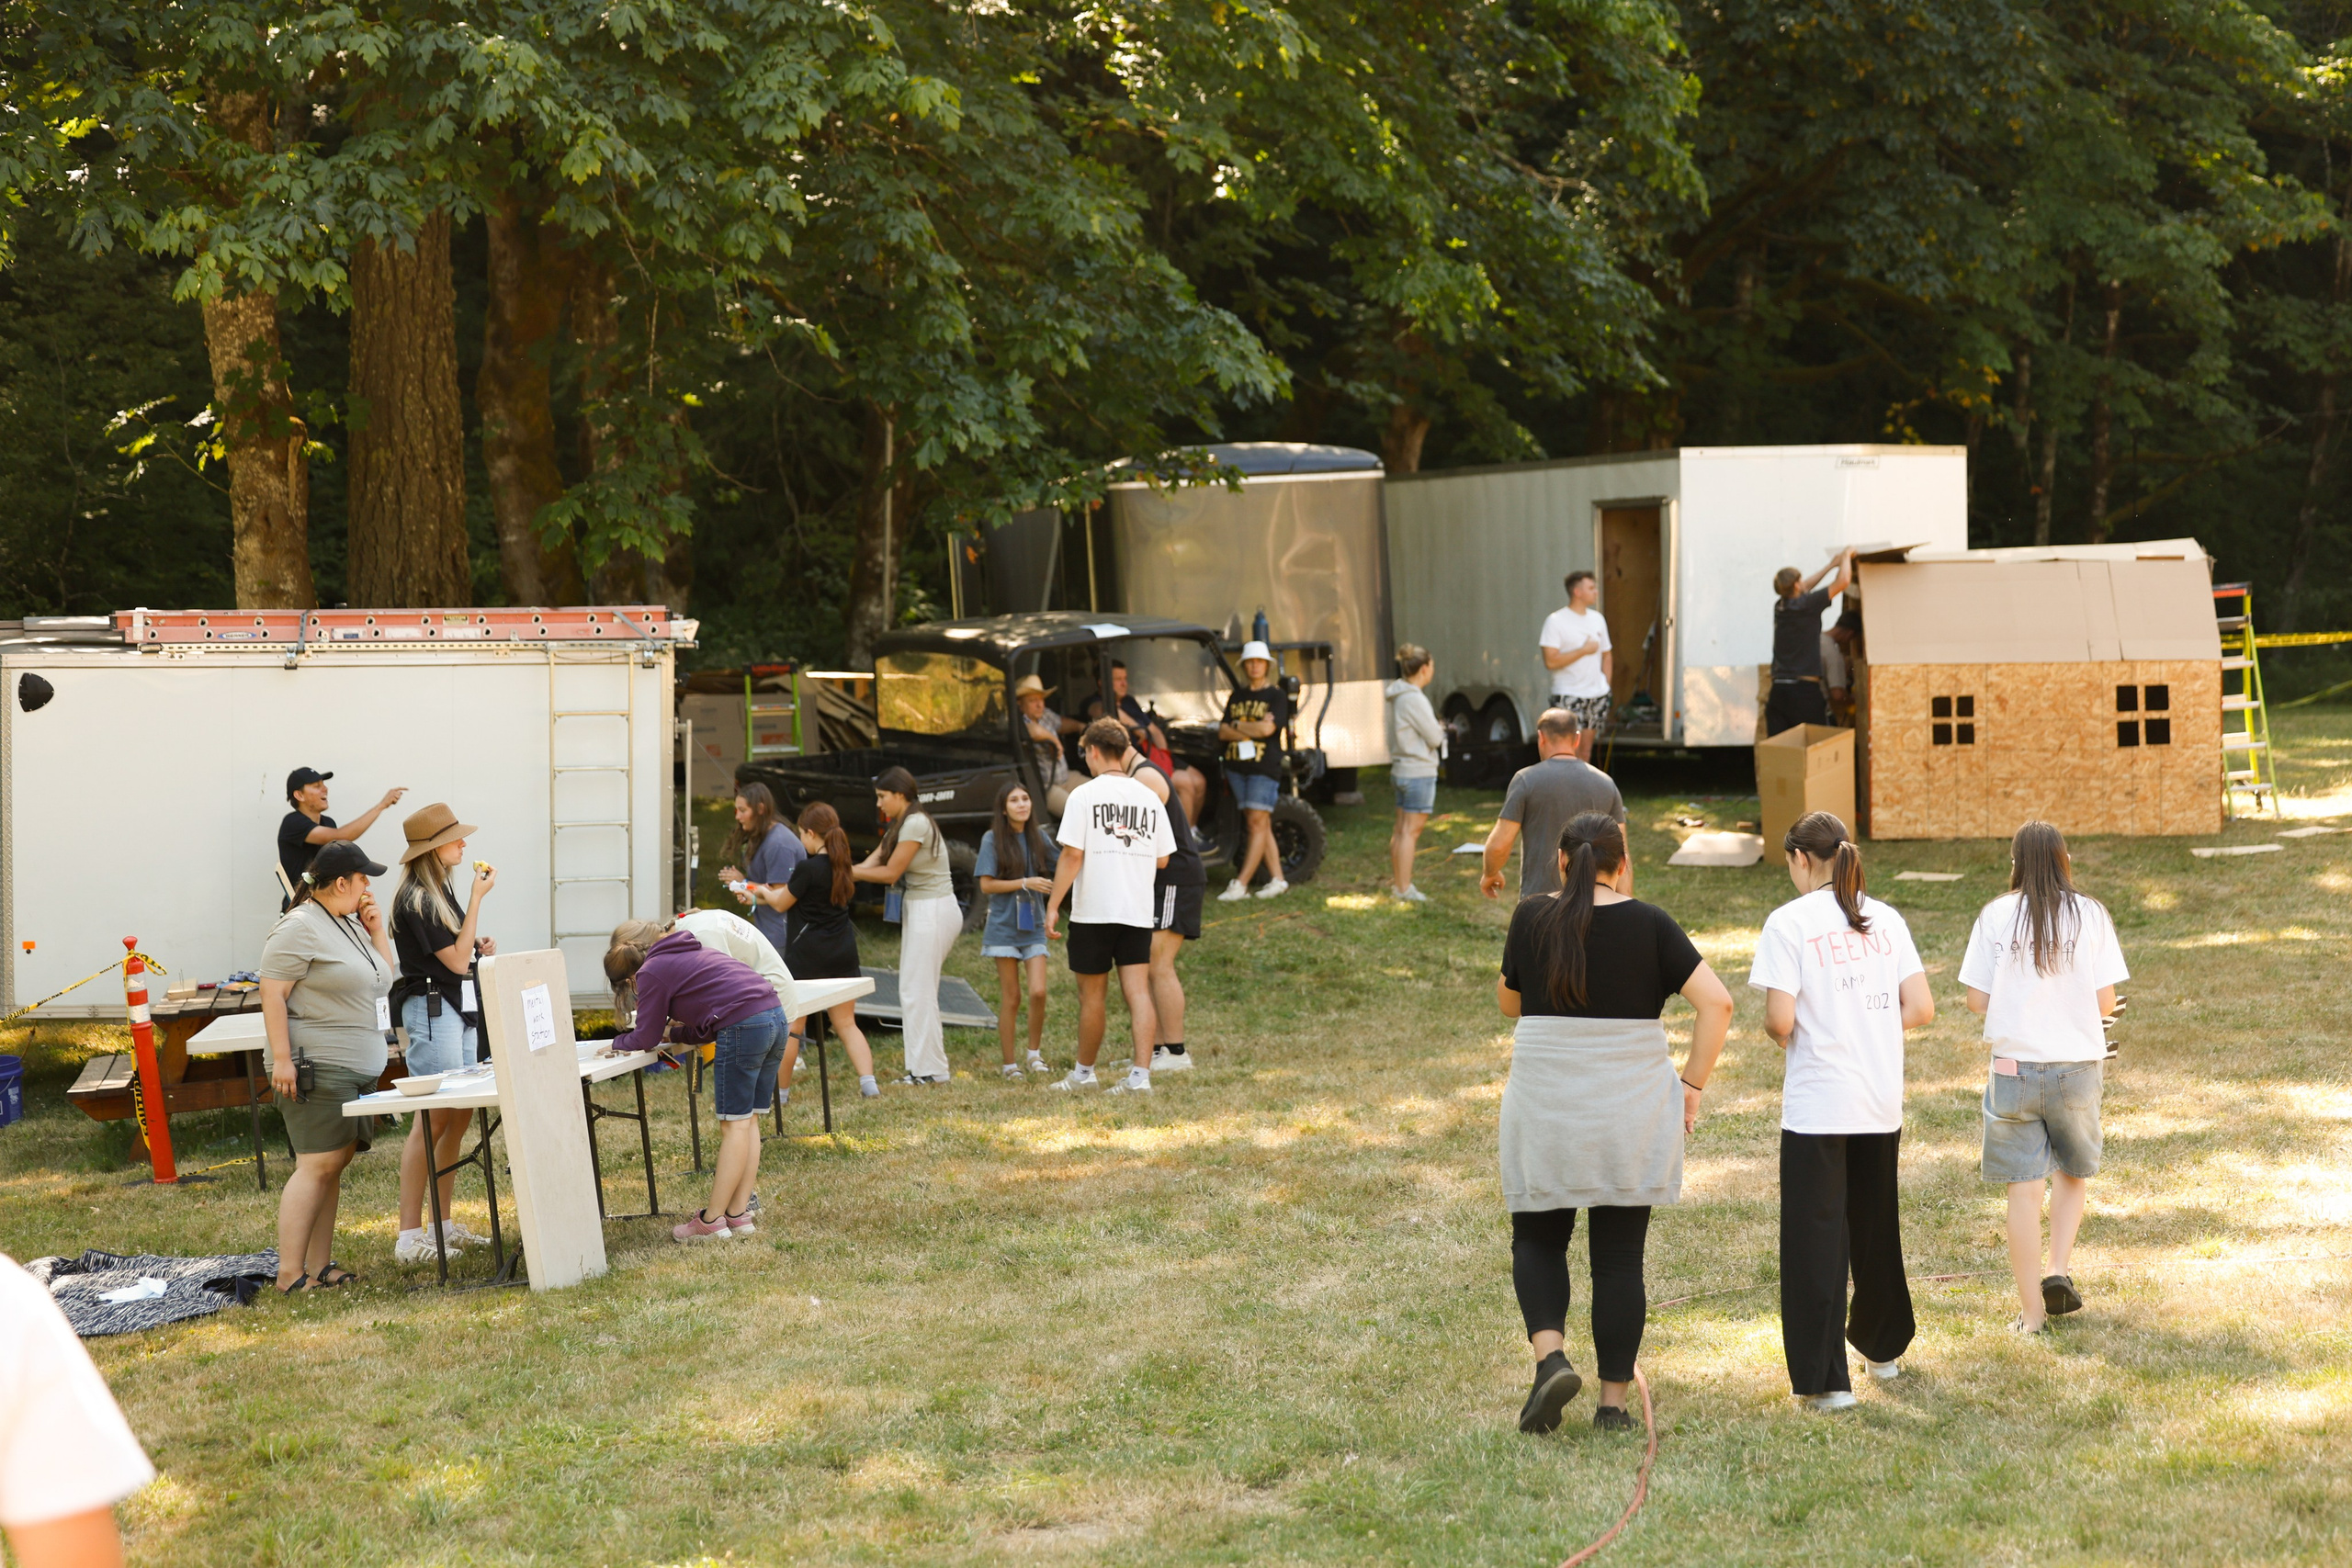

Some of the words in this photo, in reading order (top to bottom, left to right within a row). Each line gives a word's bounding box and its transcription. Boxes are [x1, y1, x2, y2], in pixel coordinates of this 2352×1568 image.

[1092, 803, 1148, 831] FORMULA
[1150, 809, 1157, 833] 1
[1806, 929, 1892, 967] TEENS
[1835, 974, 1865, 991] CAMP
[1866, 992, 1889, 1010] 202
